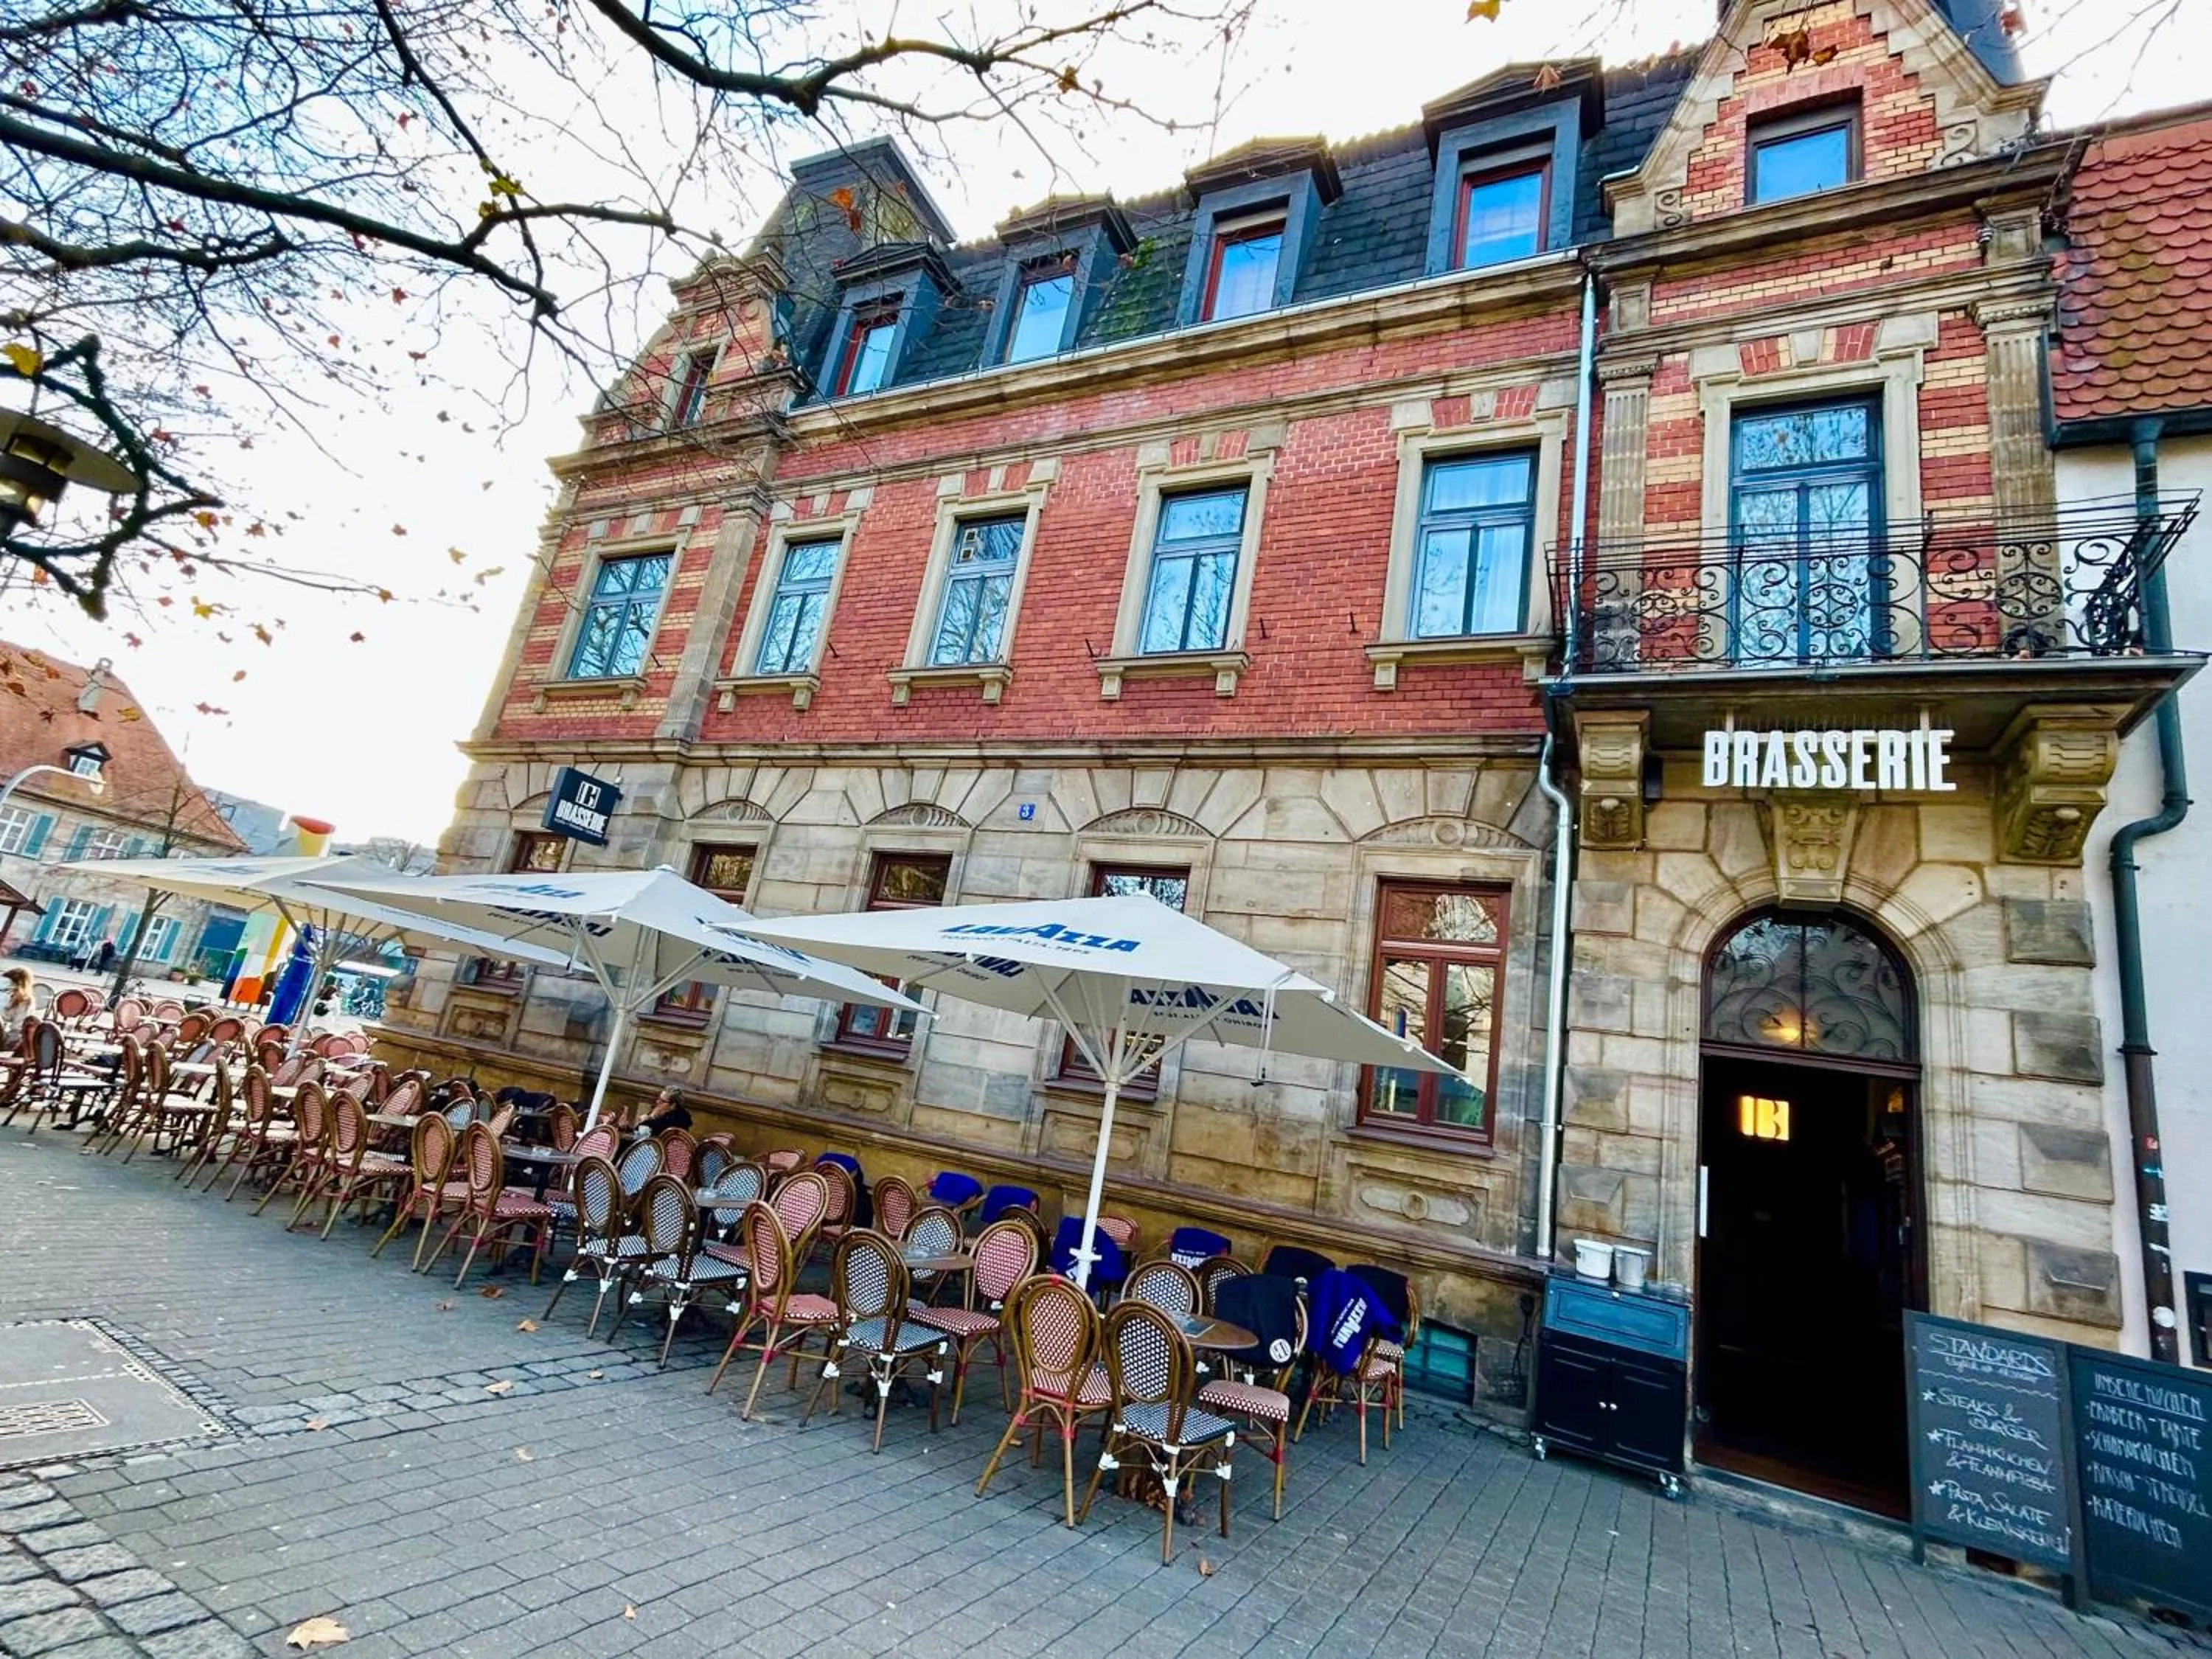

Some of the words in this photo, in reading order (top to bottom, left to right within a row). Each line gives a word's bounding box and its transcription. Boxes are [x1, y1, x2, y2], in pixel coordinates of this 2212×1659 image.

[1703, 729, 1957, 791] BRASSERIE
[555, 799, 608, 835] BRASSERIE
[939, 923, 1141, 953] LAVAZZA
[1929, 1332, 2055, 1377] STANDARDS
[1936, 1388, 1998, 1417] STEAKS
